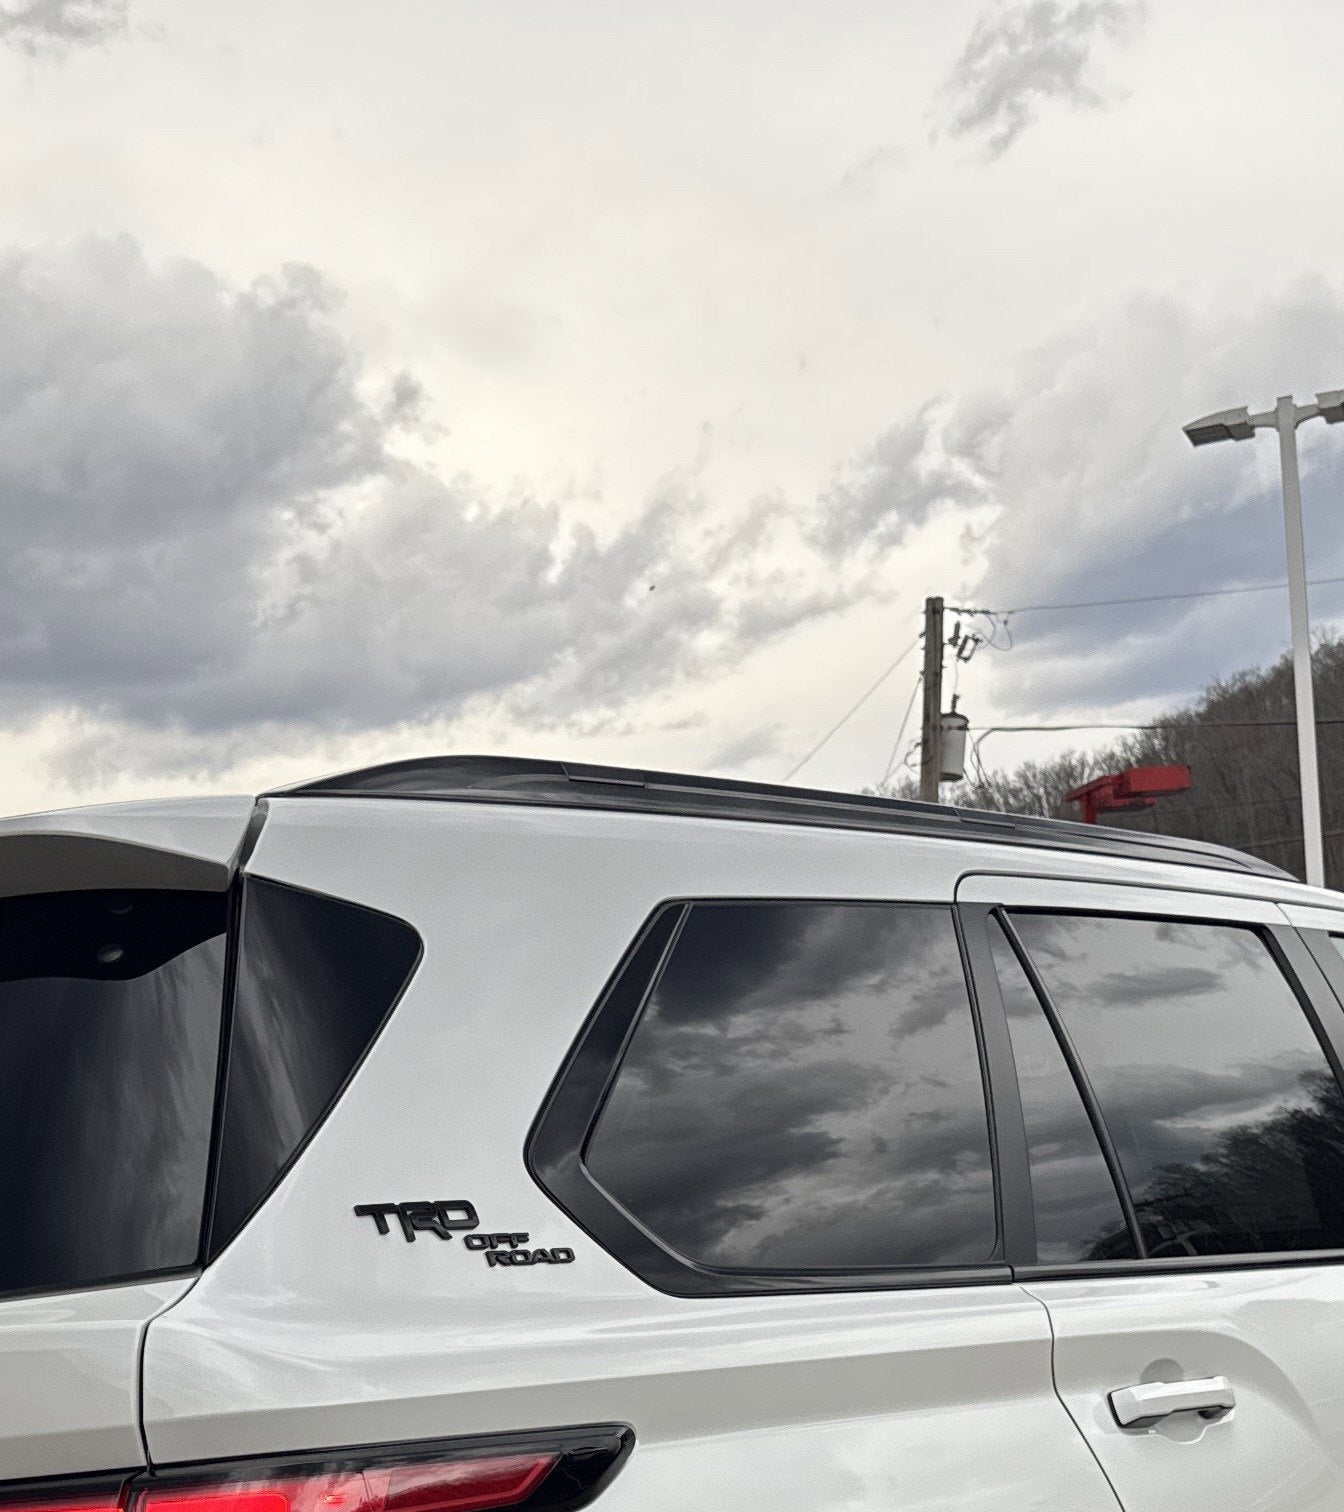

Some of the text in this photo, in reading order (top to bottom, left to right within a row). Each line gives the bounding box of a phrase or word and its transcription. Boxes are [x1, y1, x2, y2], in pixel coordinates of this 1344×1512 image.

[354, 1200, 480, 1243] TRD
[463, 1232, 529, 1250] OFF
[485, 1247, 575, 1267] ROAD
